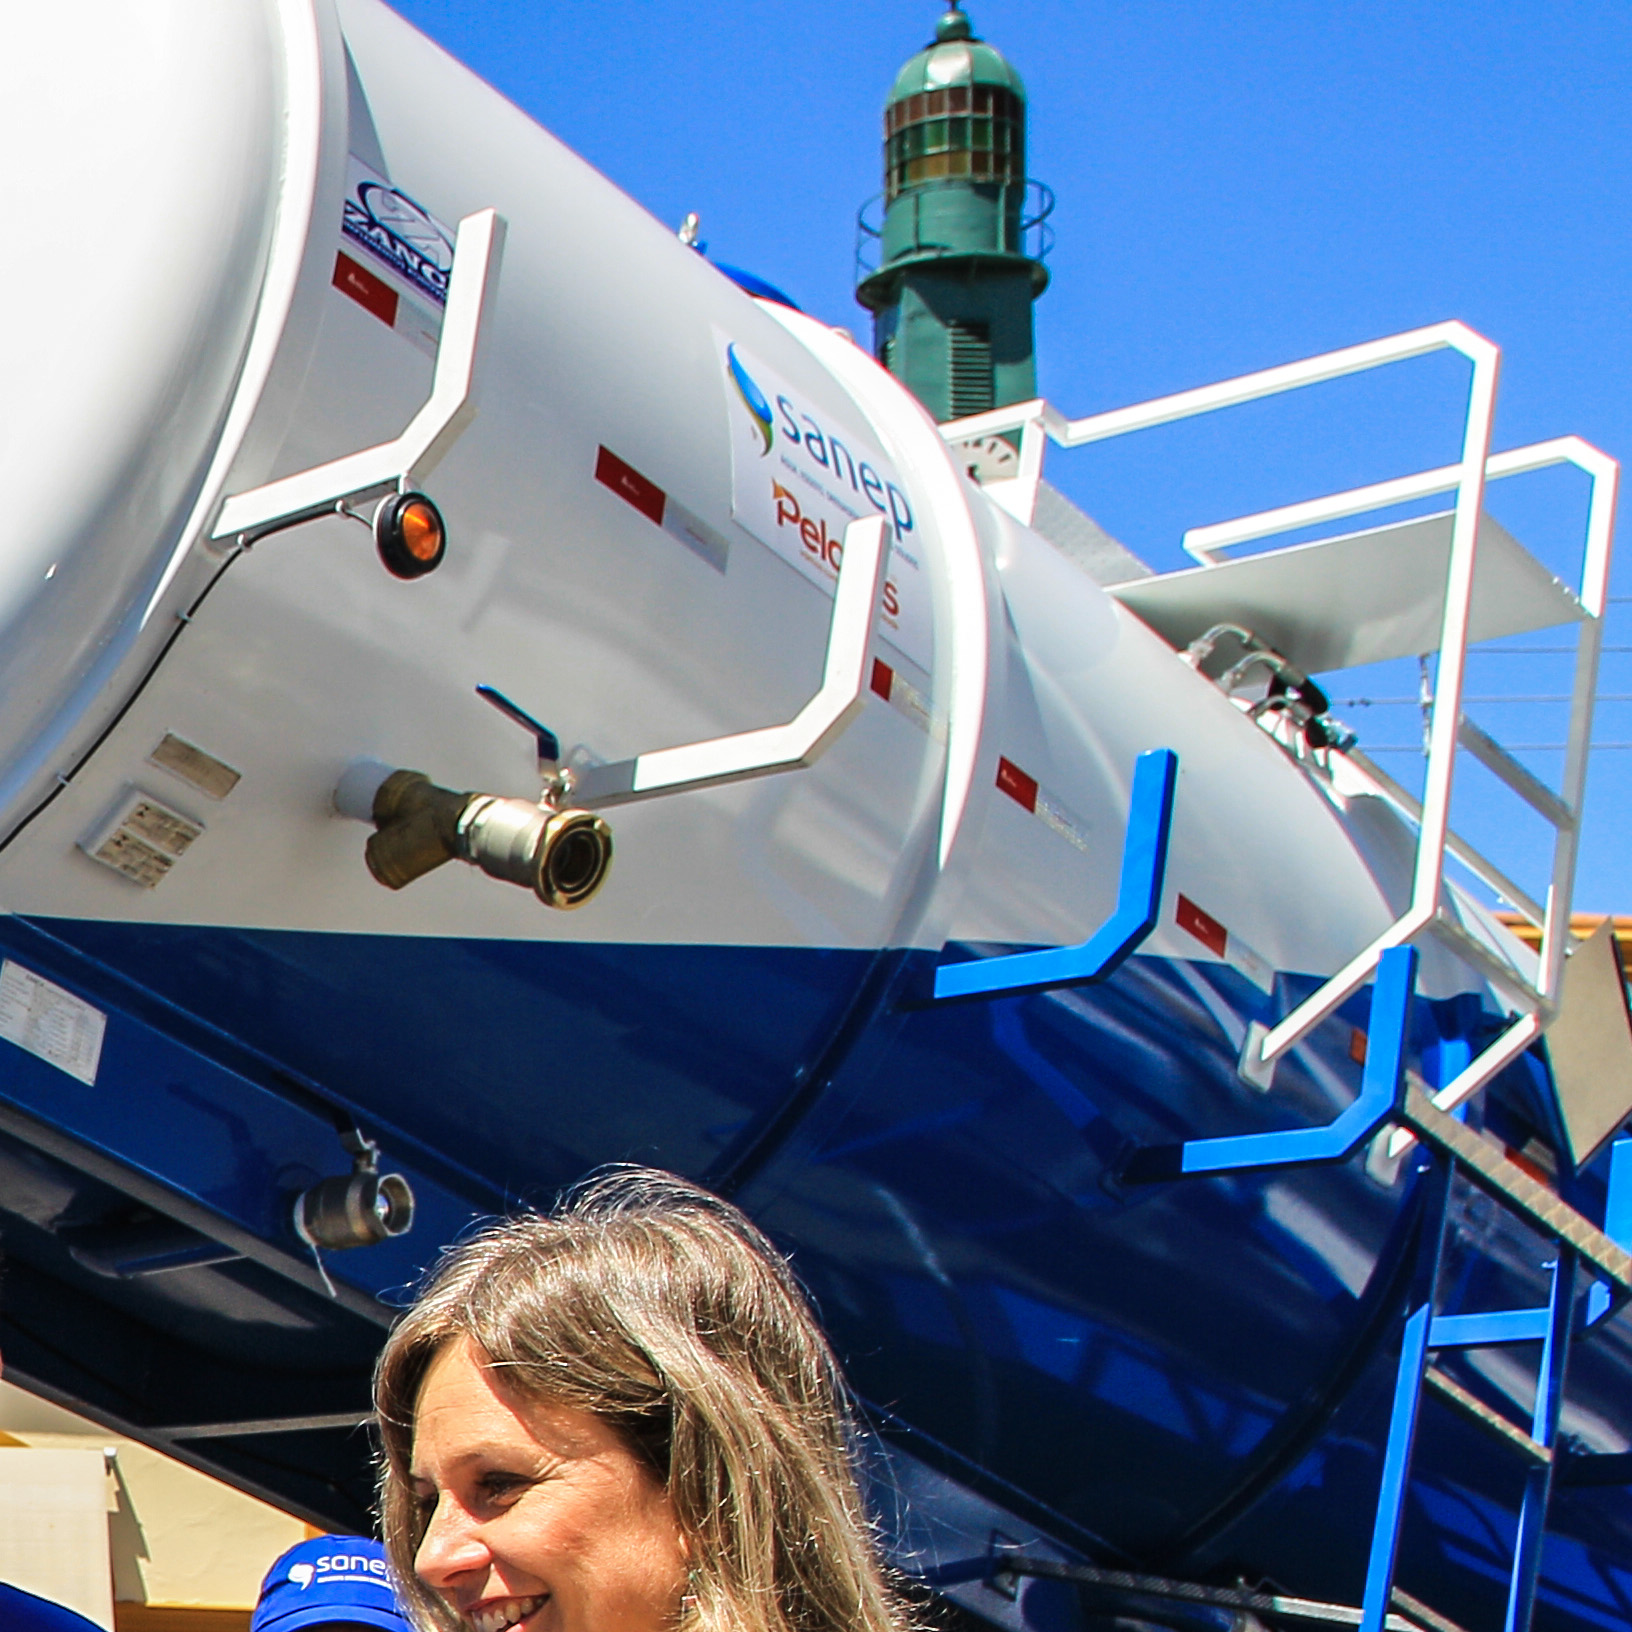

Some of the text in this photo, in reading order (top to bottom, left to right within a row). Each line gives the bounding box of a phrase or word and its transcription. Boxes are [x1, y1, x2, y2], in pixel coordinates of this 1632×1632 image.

[343, 203, 448, 290] ZANC
[777, 395, 913, 541] sanep
[772, 480, 900, 616] Pelos
[316, 1555, 390, 1582] sane
